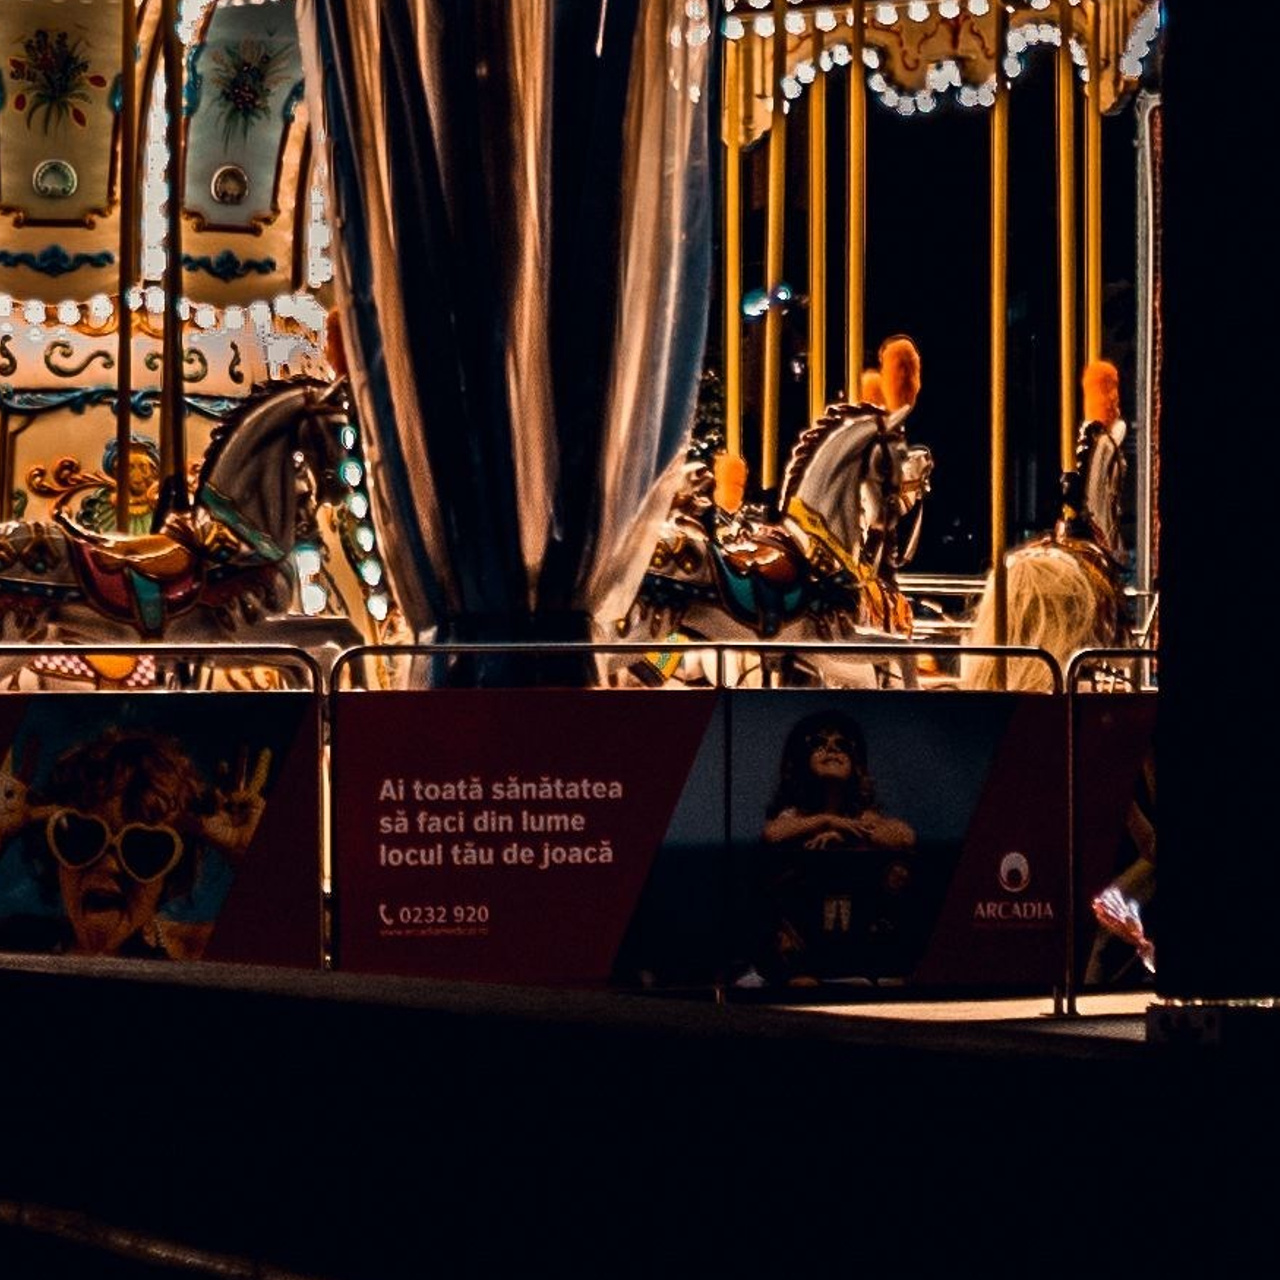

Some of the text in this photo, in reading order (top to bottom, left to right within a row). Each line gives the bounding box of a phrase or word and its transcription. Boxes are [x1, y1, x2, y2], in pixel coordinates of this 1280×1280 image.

[379, 775, 623, 801] Ai toată sănătatea
[379, 809, 586, 834] să faci din lume
[379, 839, 614, 870] locul tău de joacă
[399, 904, 490, 924] 0232 920
[973, 900, 1054, 920] ARCADIA
